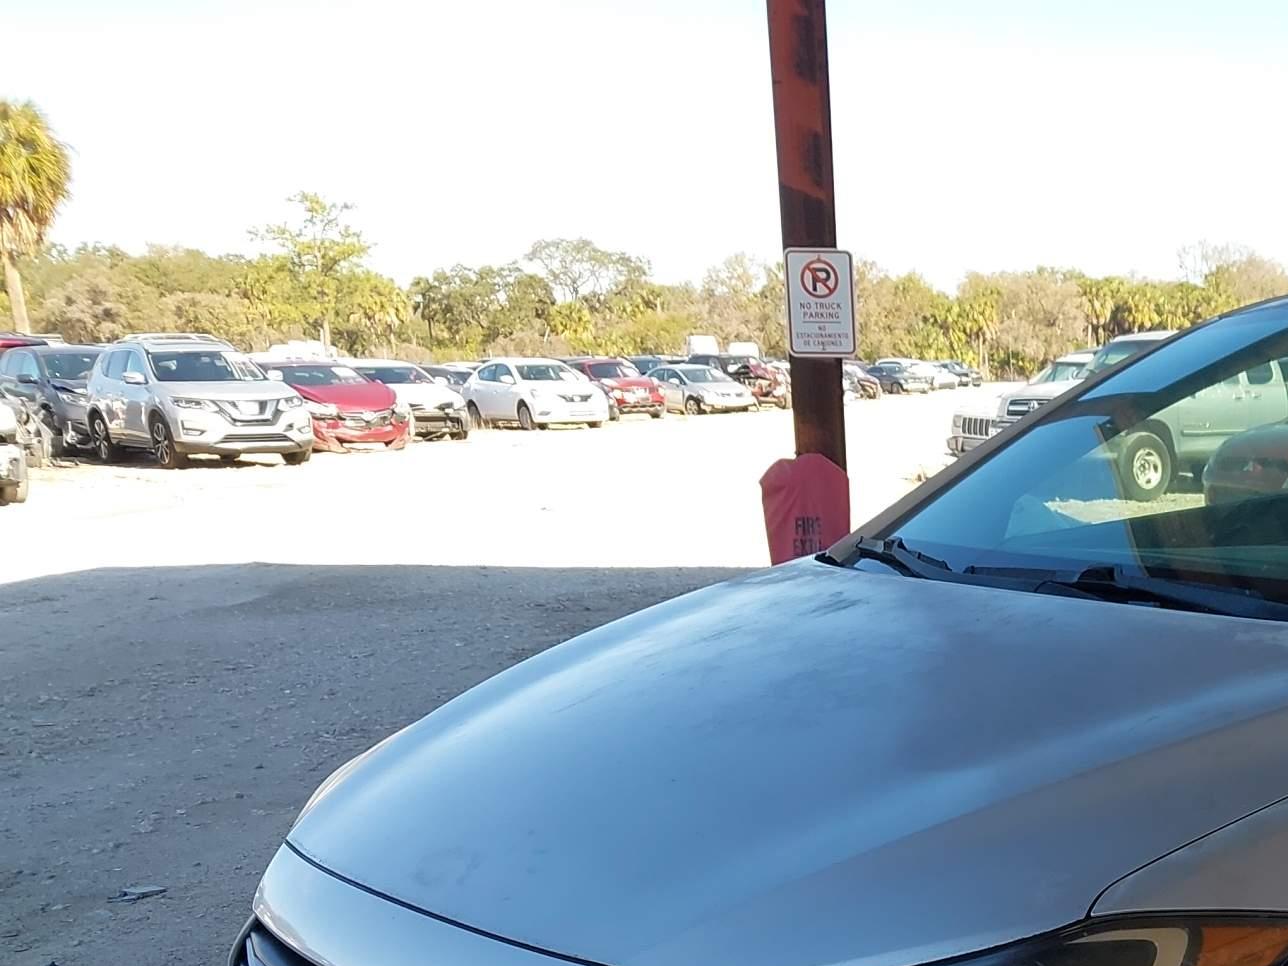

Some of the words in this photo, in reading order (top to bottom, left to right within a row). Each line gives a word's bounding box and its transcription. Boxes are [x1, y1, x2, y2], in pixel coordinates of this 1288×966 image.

[800, 302, 811, 310] NO
[815, 302, 842, 310] TRUCK
[803, 311, 840, 320] PARKING
[795, 515, 822, 535] FIRE
